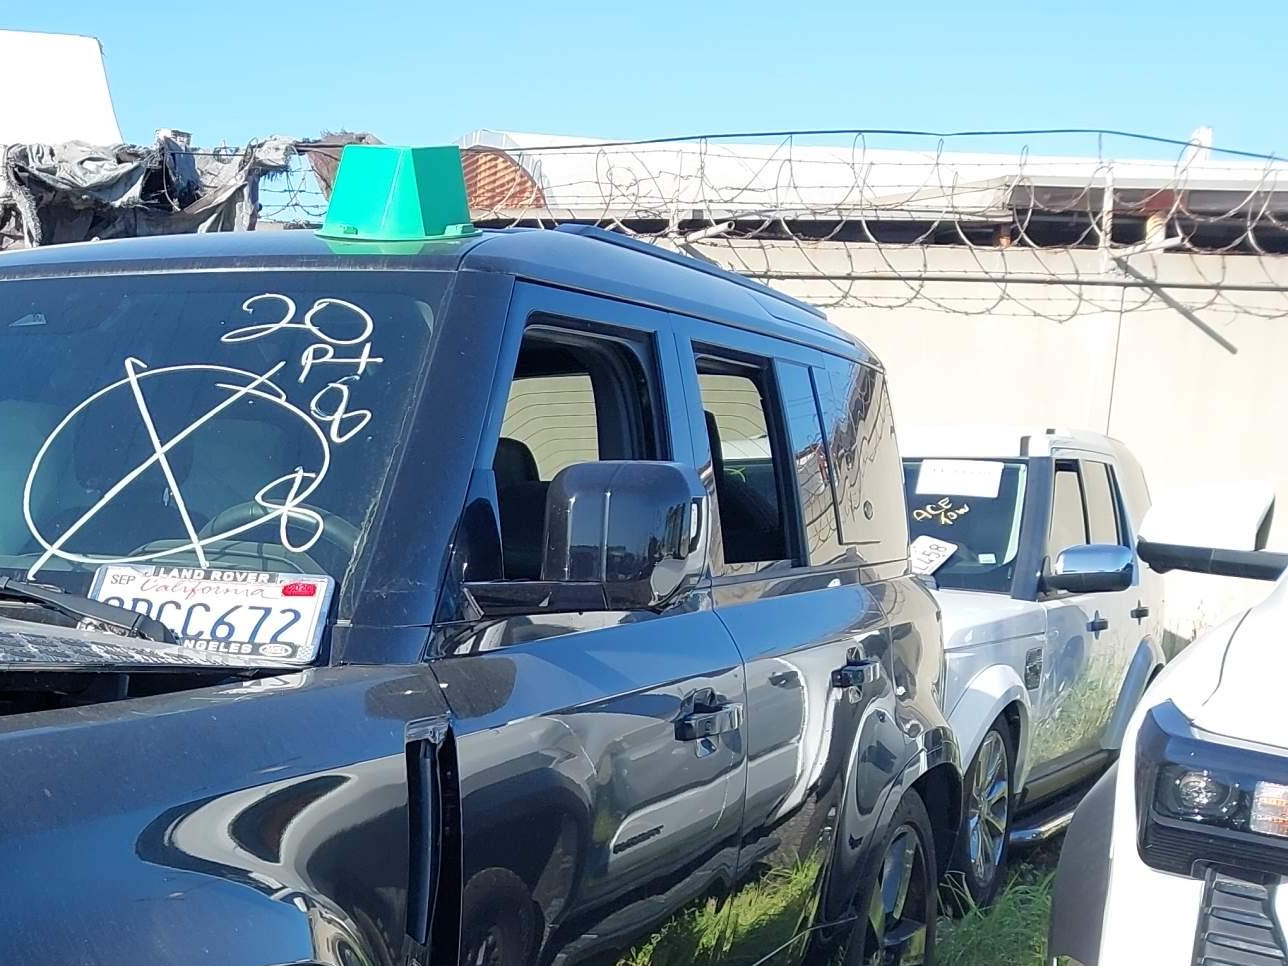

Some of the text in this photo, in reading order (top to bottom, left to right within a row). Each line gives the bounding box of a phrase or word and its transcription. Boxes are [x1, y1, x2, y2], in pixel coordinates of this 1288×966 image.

[110, 573, 136, 586] SEP
[161, 569, 271, 584] LAND ROVER
[140, 571, 280, 600] California
[182, 638, 253, 654] NGELES
